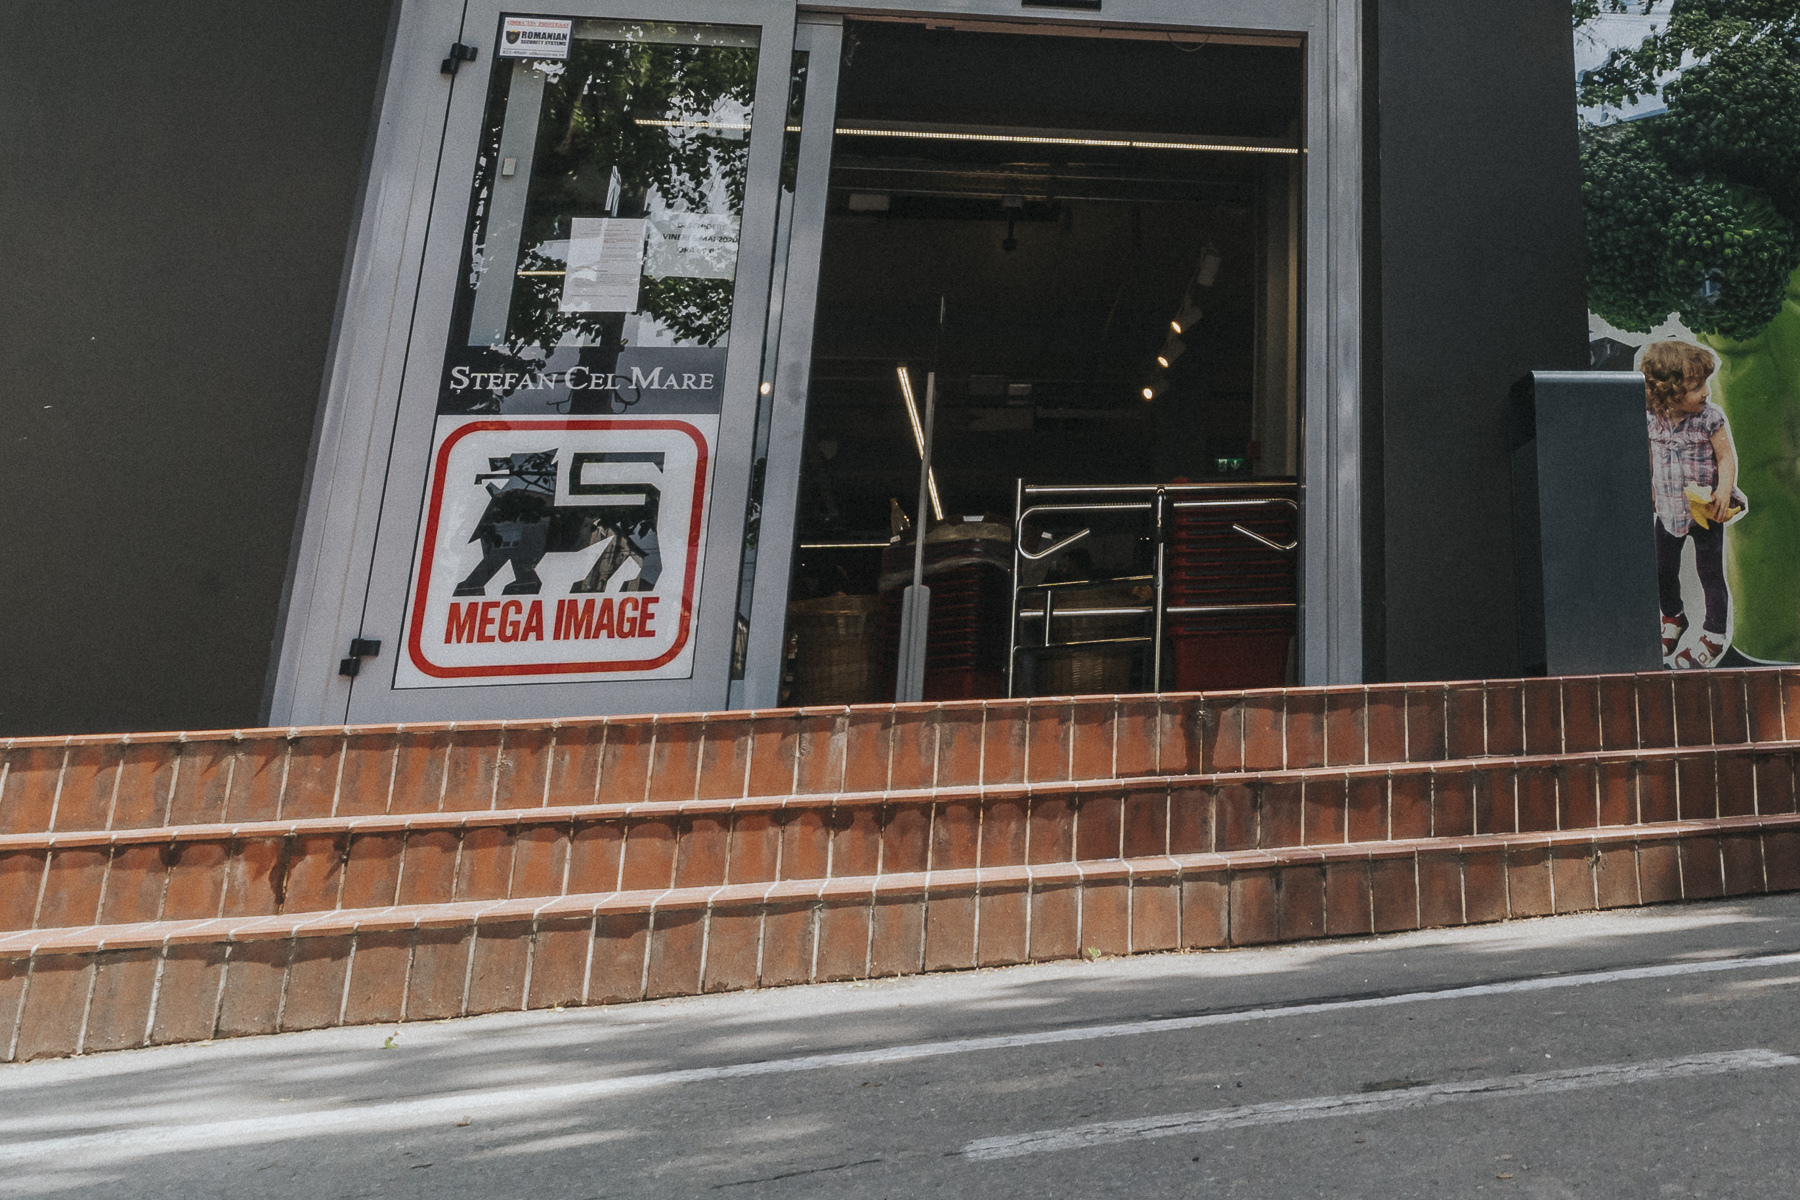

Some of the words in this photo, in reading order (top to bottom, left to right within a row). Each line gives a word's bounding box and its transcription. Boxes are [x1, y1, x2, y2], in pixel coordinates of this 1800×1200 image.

[521, 31, 568, 41] ROMANIAN
[627, 366, 714, 390] MARE
[444, 599, 544, 645] MEGA
[552, 596, 660, 641] IMAGE
